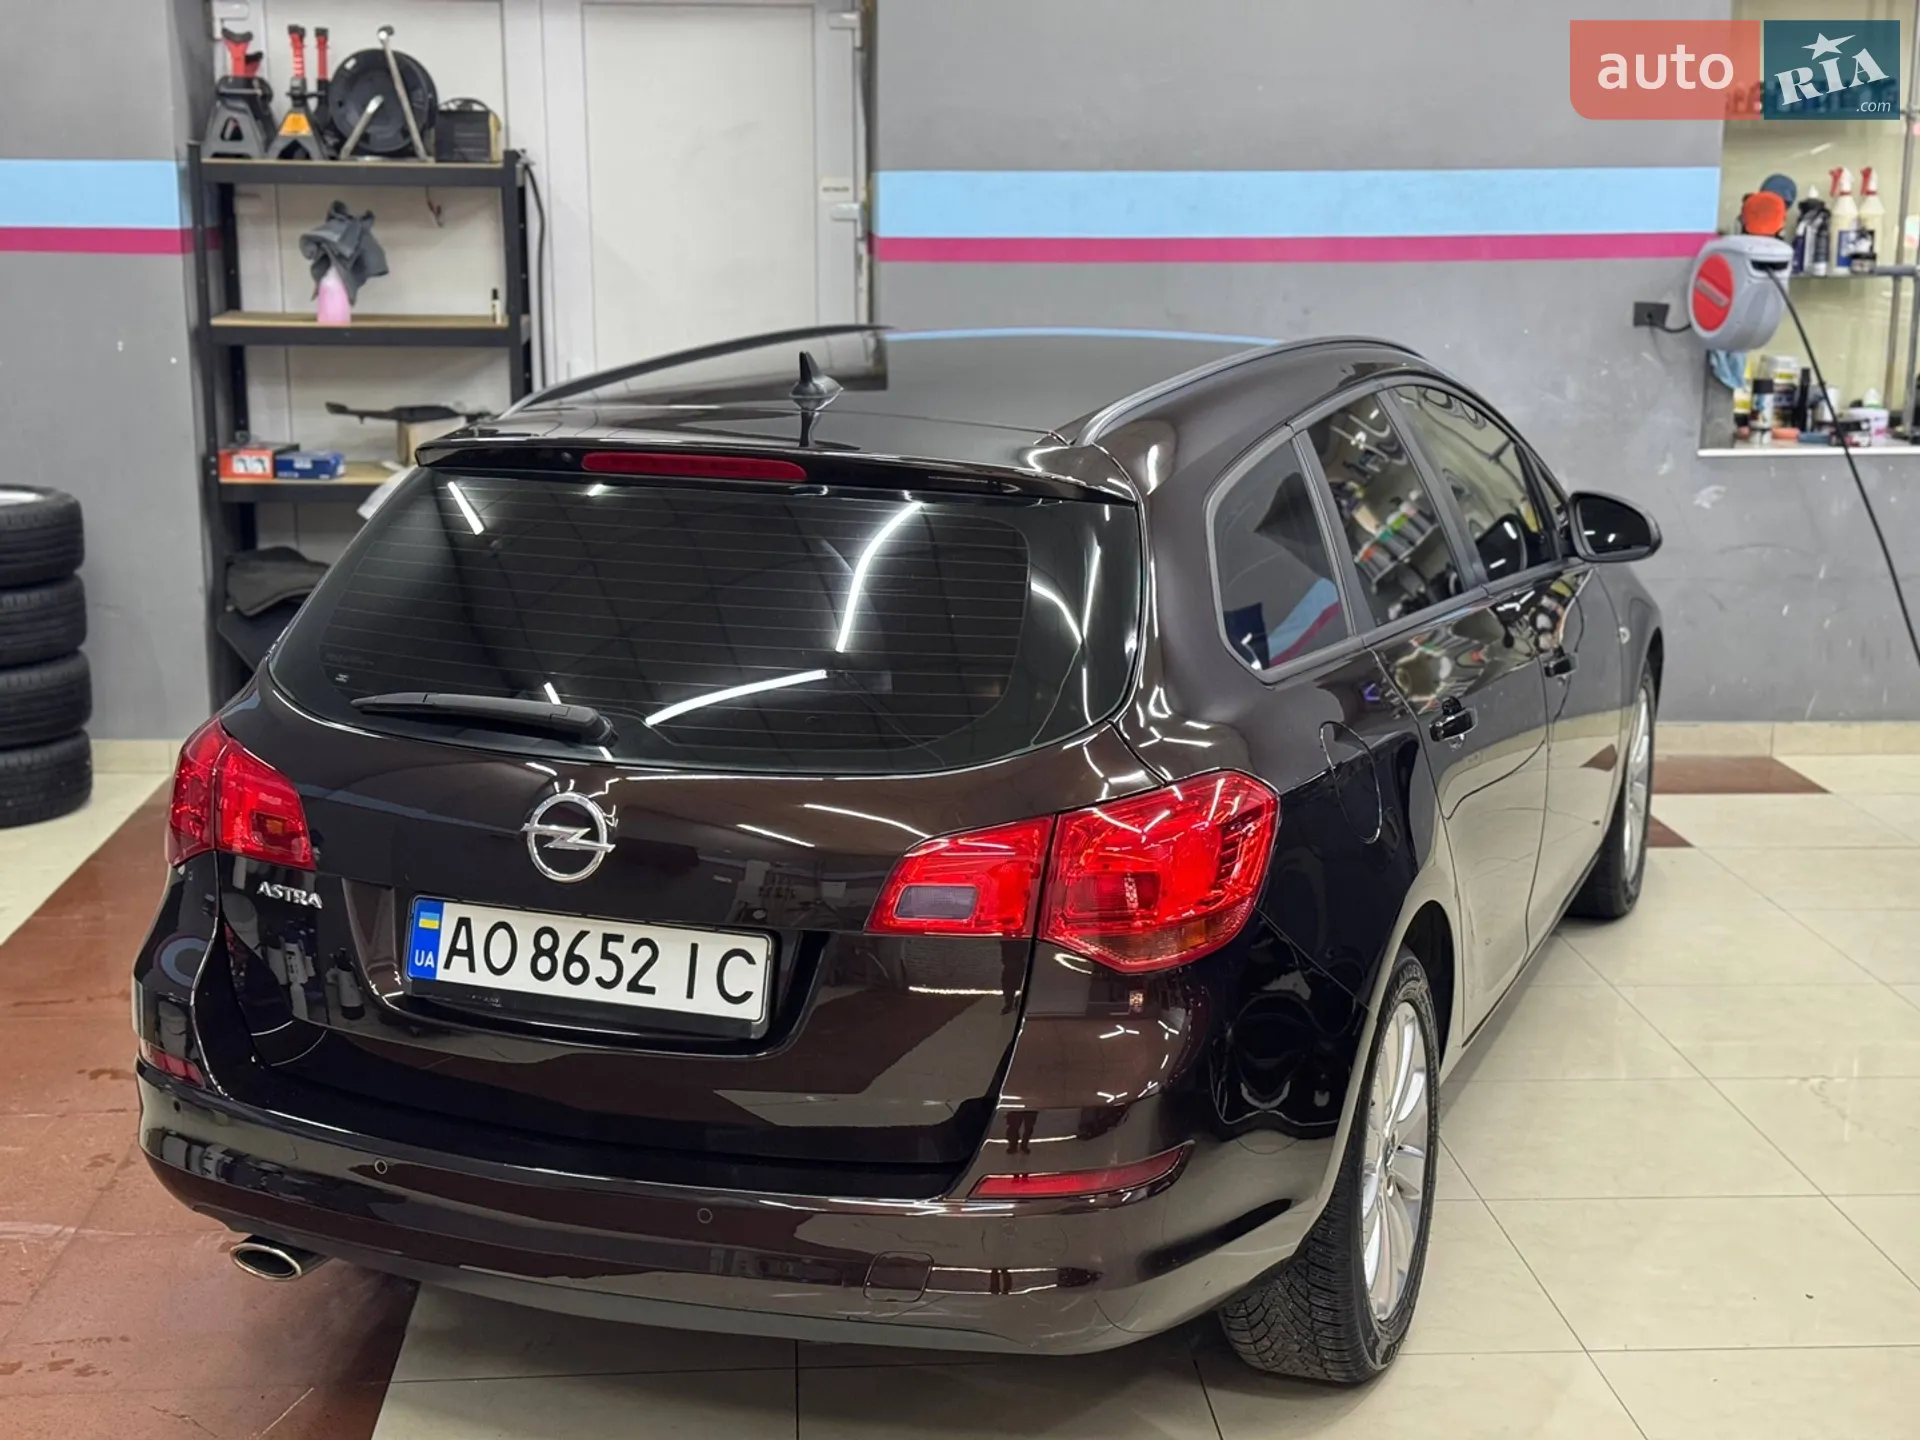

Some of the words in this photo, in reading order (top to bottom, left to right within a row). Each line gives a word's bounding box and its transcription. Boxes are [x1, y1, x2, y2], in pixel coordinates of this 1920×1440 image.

[257, 881, 323, 909] ASTRA
[414, 951, 435, 969] UA
[443, 917, 517, 975] AO
[530, 926, 660, 995] 8652
[686, 942, 757, 1005] IC
